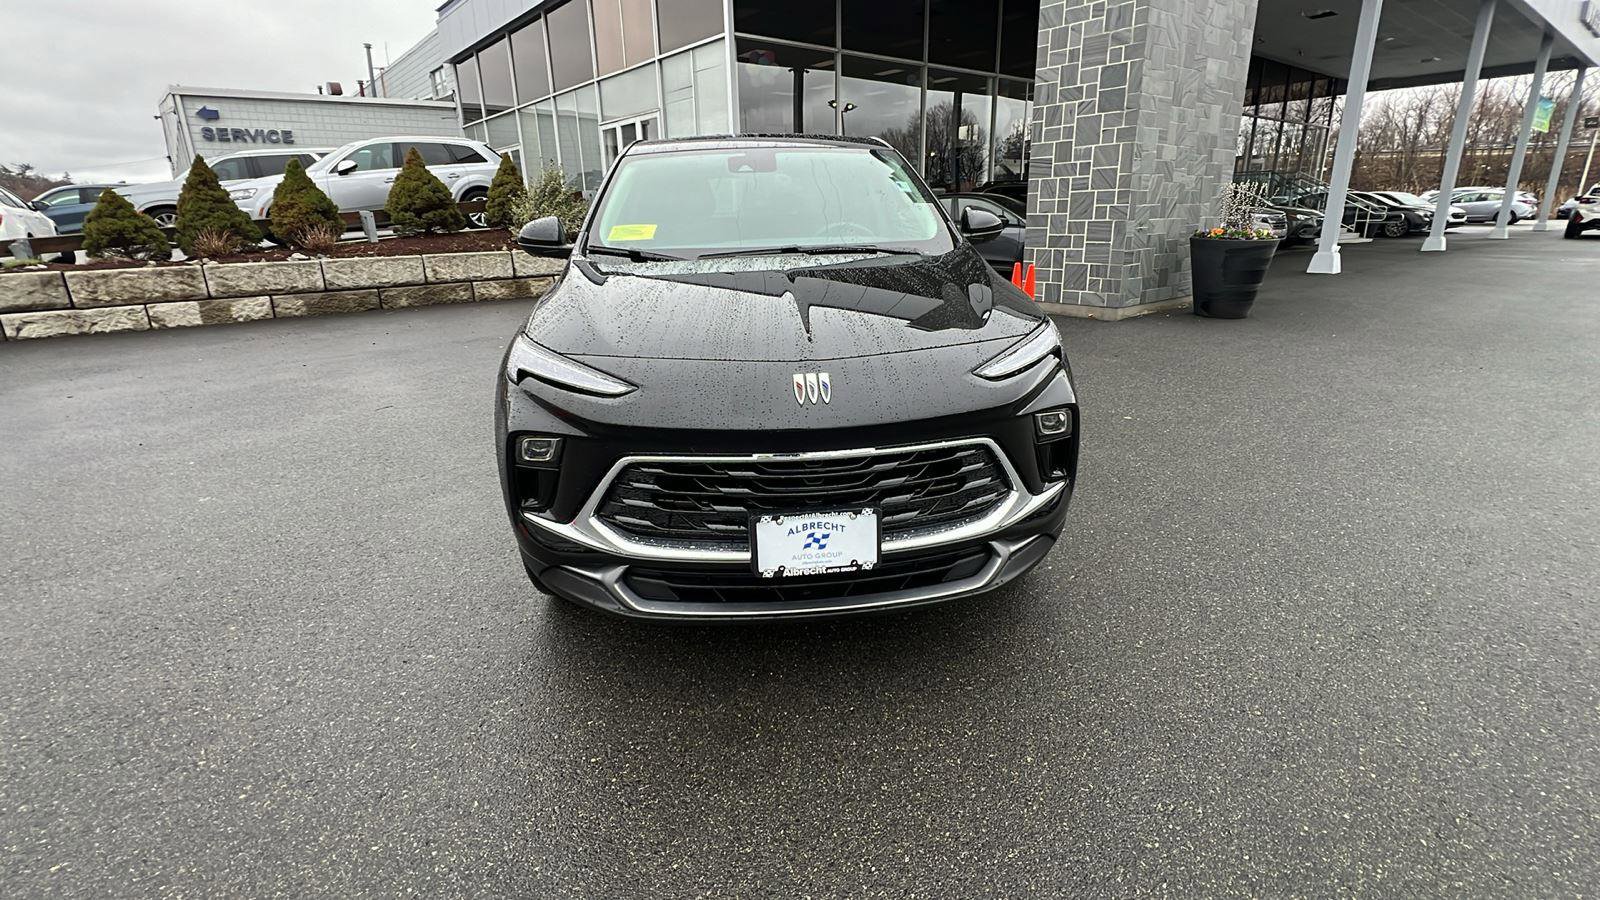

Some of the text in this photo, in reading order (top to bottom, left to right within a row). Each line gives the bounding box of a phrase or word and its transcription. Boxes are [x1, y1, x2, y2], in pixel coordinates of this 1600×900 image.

[201, 126, 295, 145] SERVICE
[787, 521, 846, 537] ALBRECHT
[791, 551, 842, 561] AUTO GROUP
[782, 566, 826, 577] Albrecht
